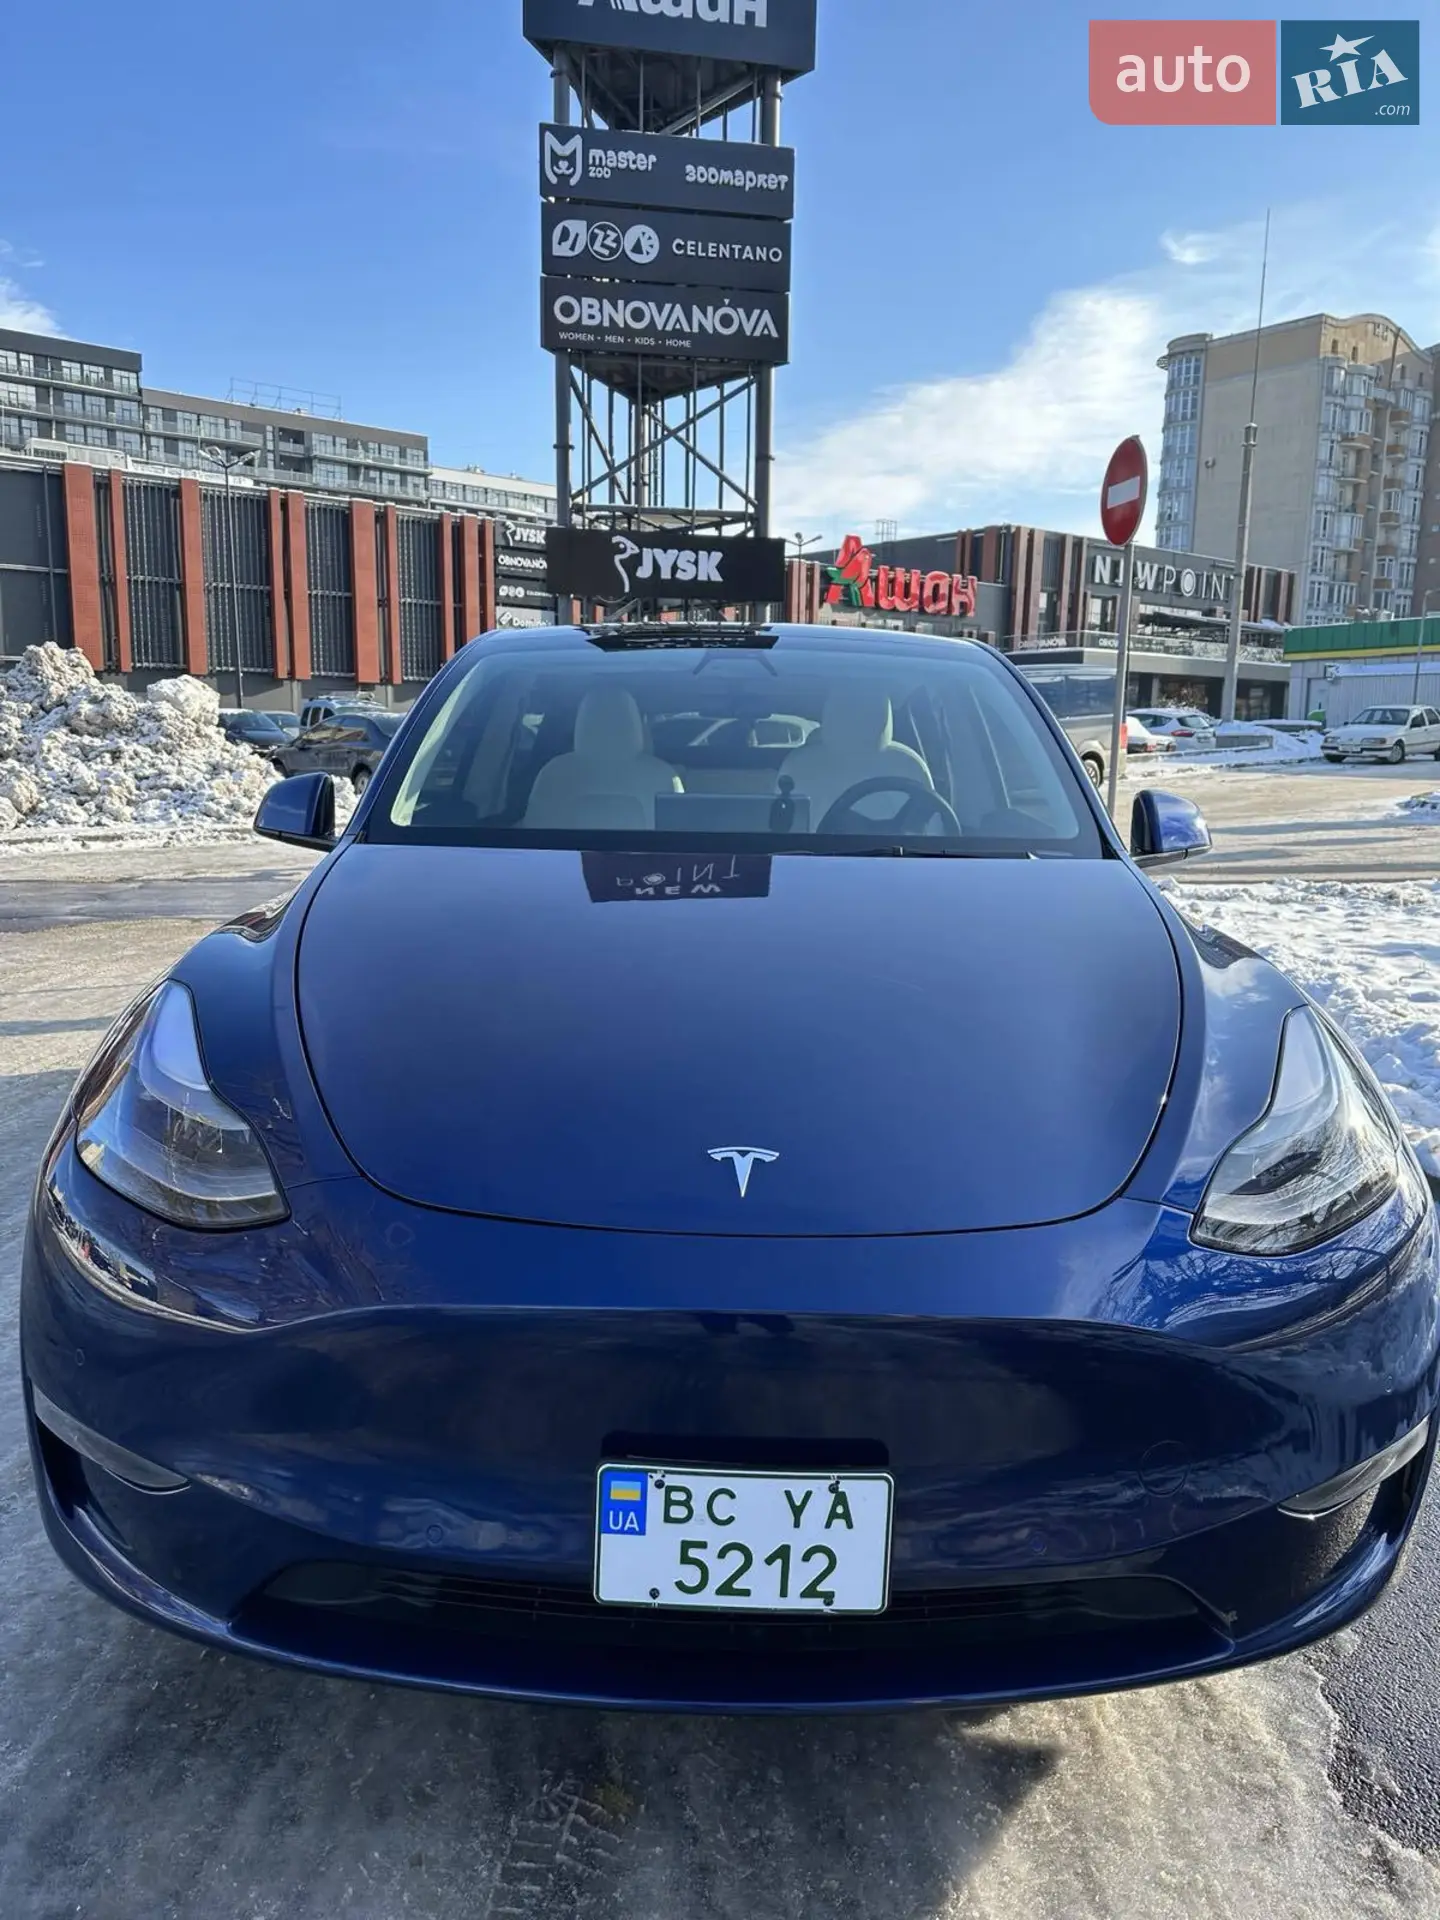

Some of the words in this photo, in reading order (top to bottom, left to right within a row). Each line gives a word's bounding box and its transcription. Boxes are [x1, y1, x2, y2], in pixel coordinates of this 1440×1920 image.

[588, 148, 657, 171] master
[671, 237, 783, 263] CELENTANO
[558, 331, 595, 342] WOMEN
[604, 335, 625, 344] MEN
[634, 336, 656, 346] KIDS
[665, 338, 692, 348] HOME
[513, 527, 547, 545] JYSK
[635, 547, 724, 582] JYSK
[608, 1510, 640, 1532] UA
[674, 1539, 838, 1599] 5212
